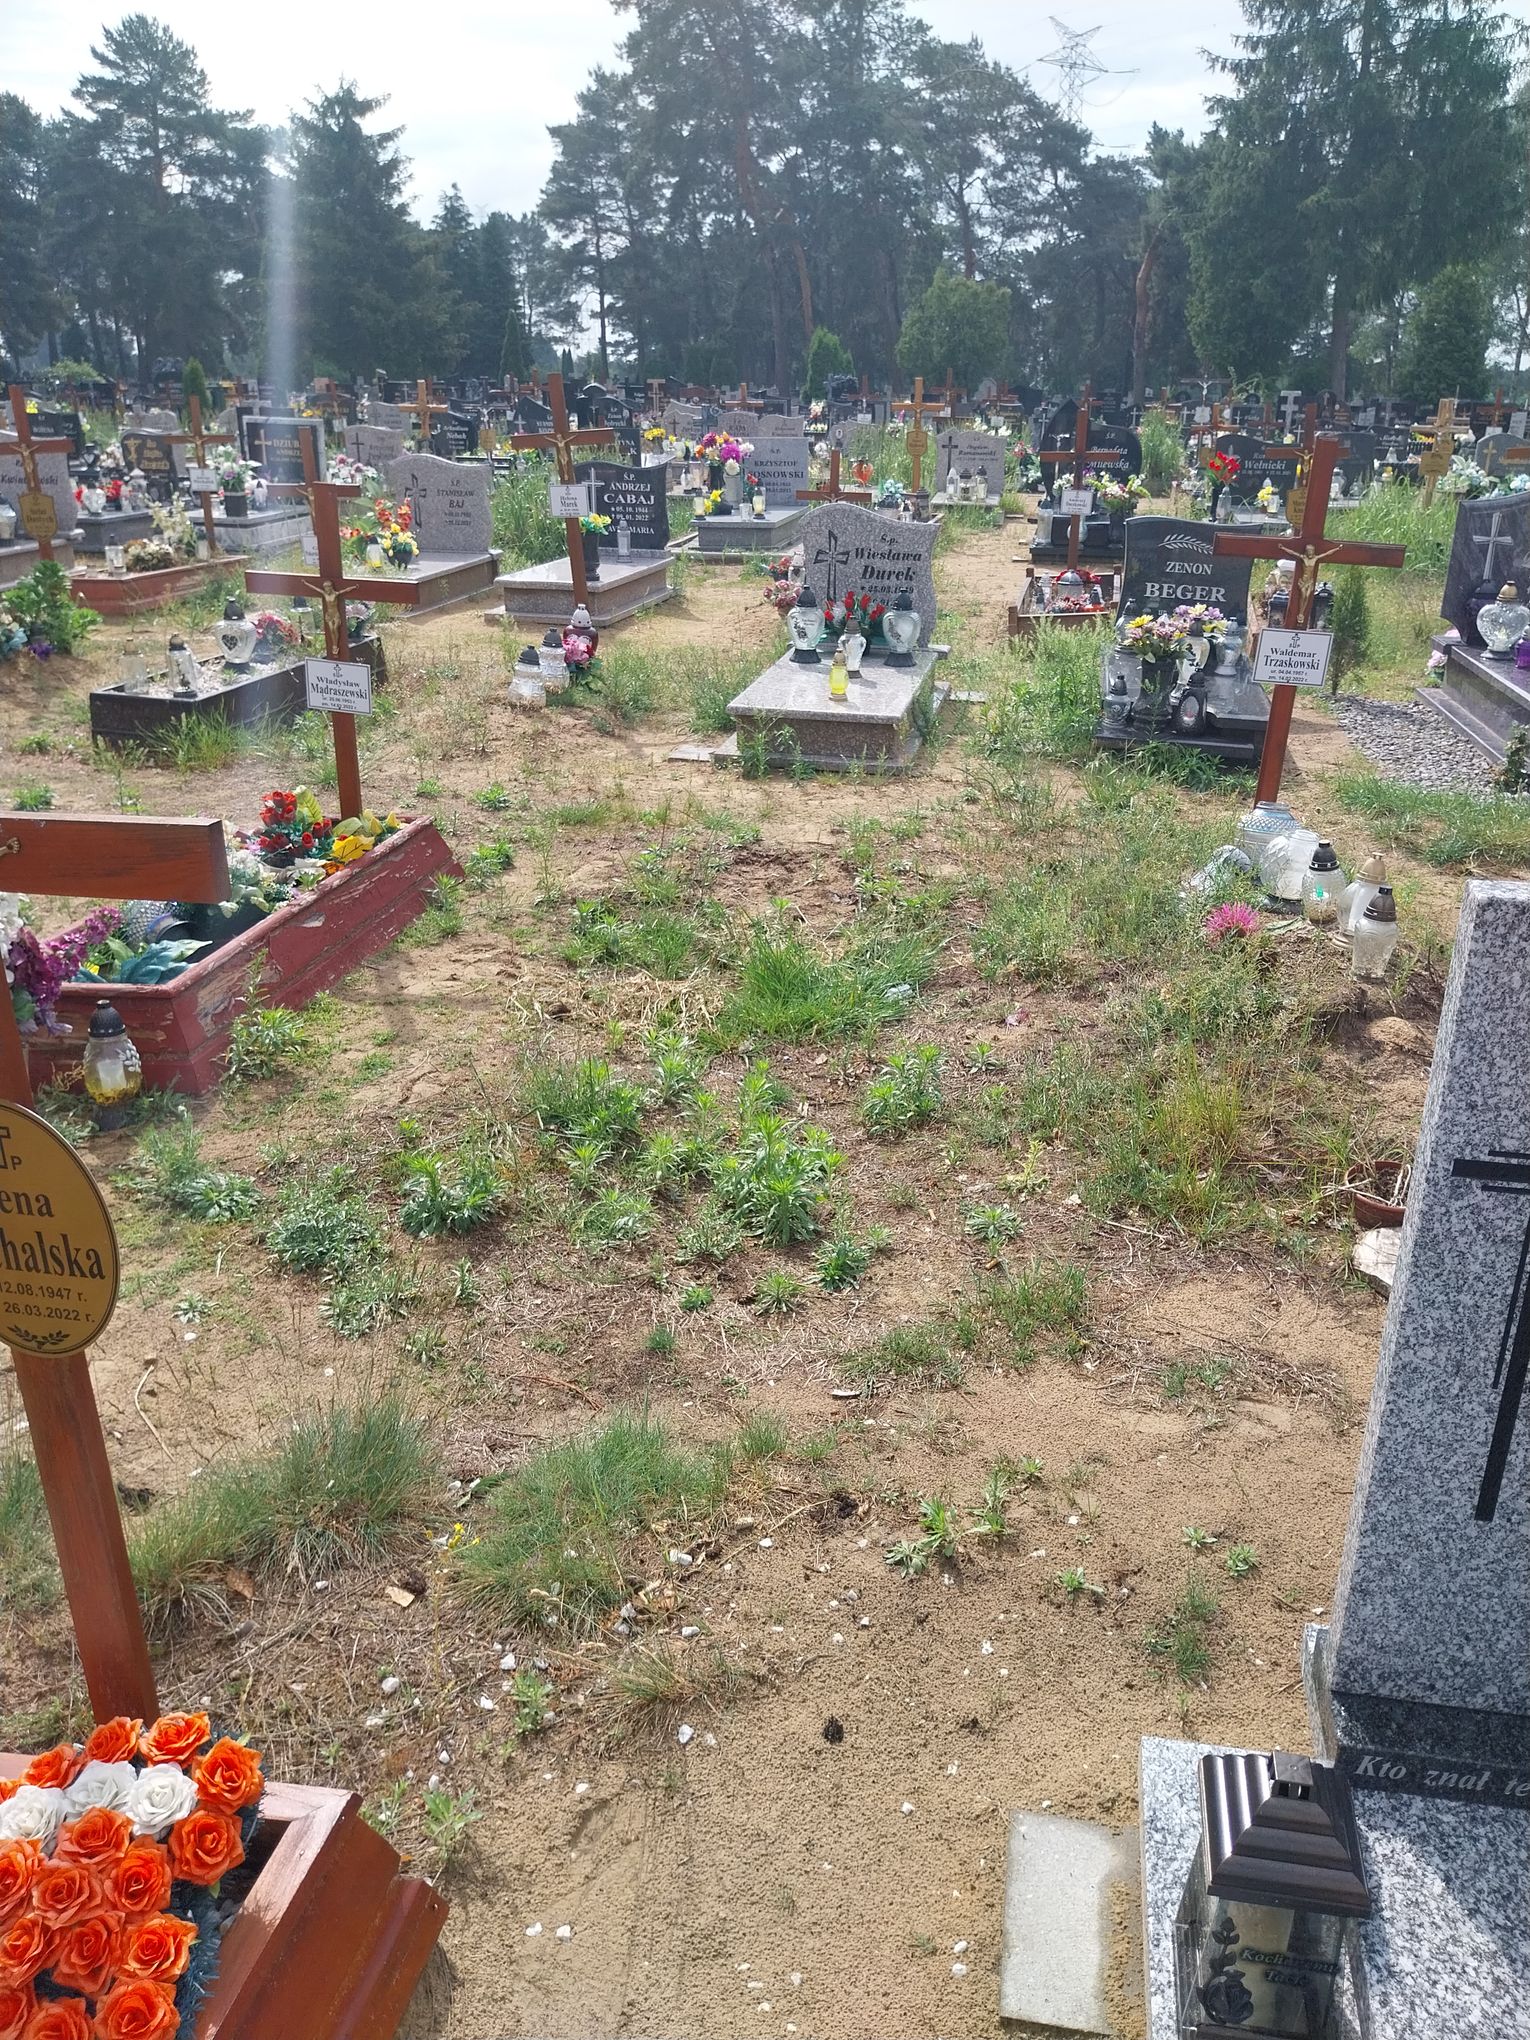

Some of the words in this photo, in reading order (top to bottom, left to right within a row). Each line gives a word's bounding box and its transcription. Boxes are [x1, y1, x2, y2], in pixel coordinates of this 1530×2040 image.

[750, 471, 804, 479] OSNOWSKI
[609, 482, 651, 492] ANDRZEJ
[603, 493, 655, 505] CABAJ
[854, 547, 922, 562] Wiesława
[860, 565, 916, 581] Durek
[1165, 561, 1214, 575] ZENON
[1143, 582, 1227, 602] BEGER
[1270, 647, 1317, 658] Waldemar
[1263, 654, 1320, 670] Trzaskowski
[310, 682, 368, 700] Mądraszewski
[0, 1227, 106, 1280] halska
[3, 1301, 81, 1321] 26.03.2022
[1353, 1755, 1408, 1780] Kto
[1423, 1770, 1492, 1791] znał
